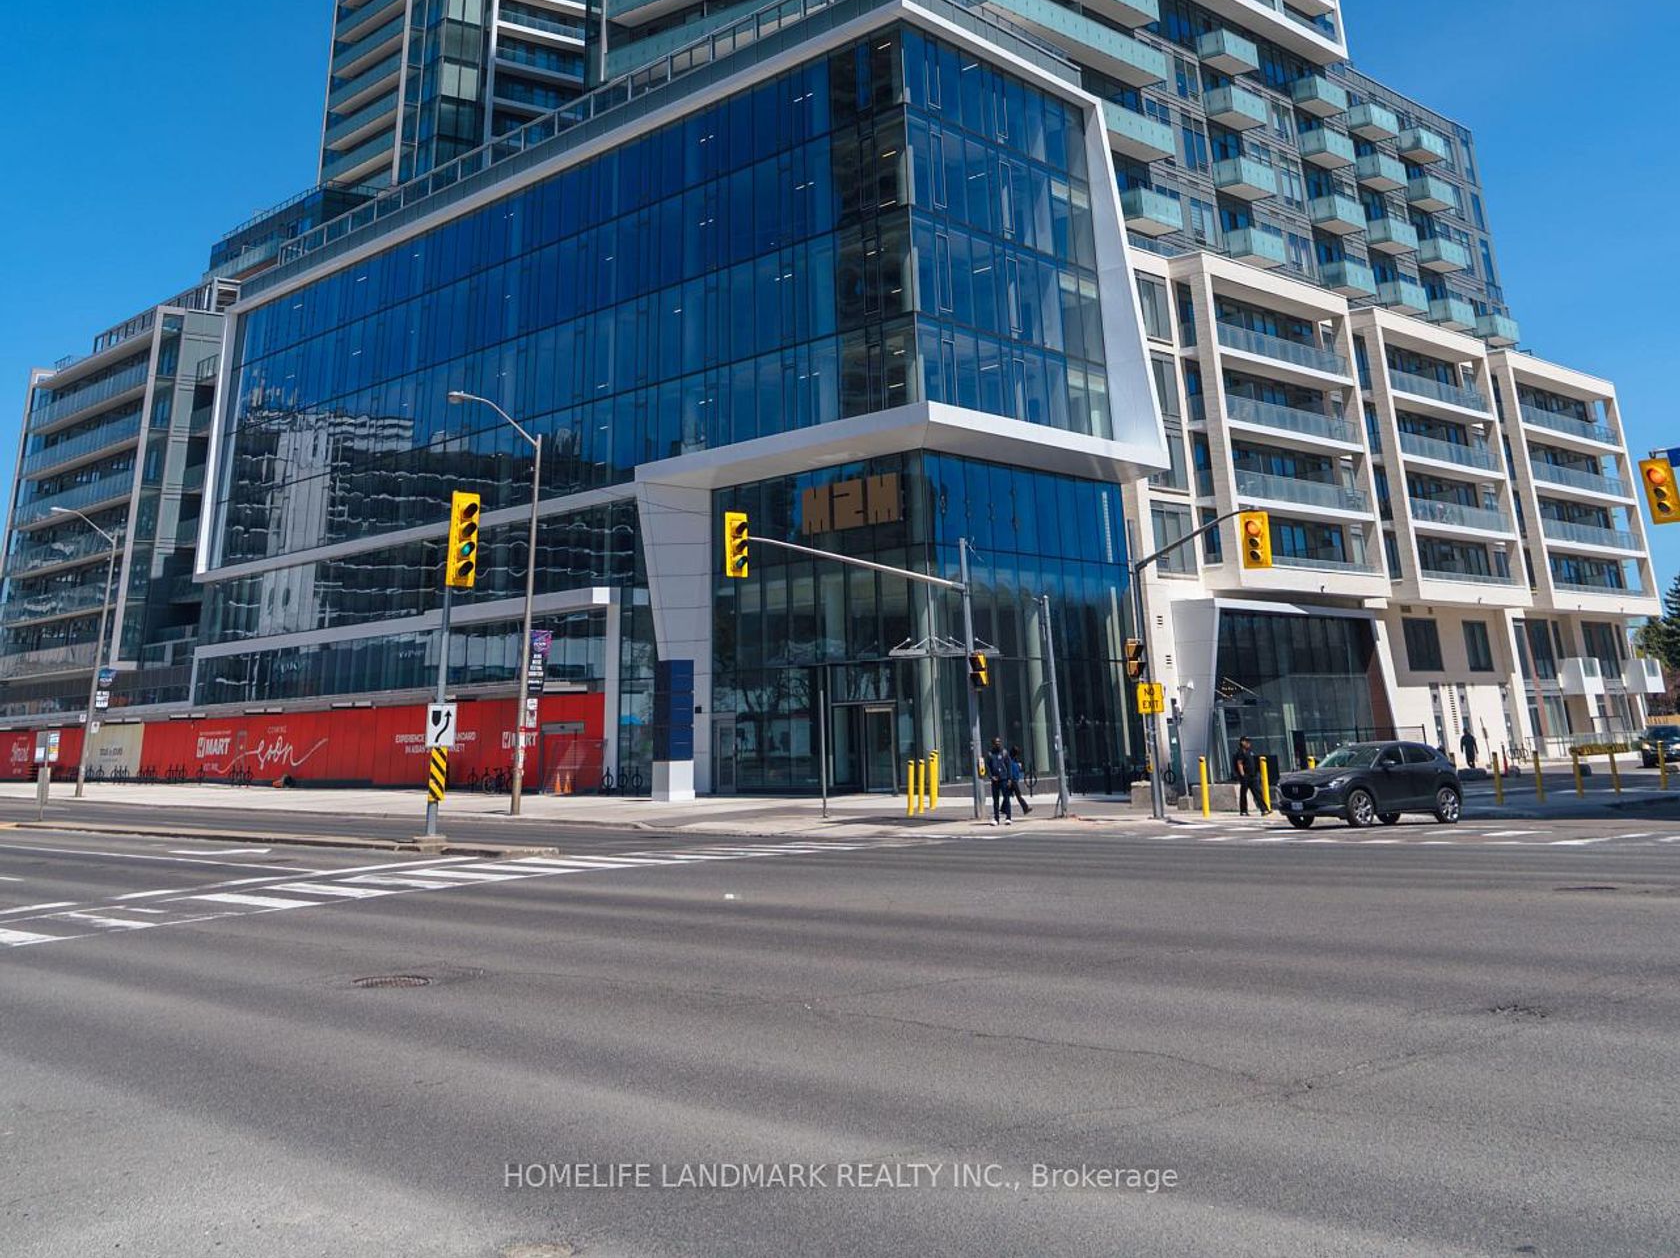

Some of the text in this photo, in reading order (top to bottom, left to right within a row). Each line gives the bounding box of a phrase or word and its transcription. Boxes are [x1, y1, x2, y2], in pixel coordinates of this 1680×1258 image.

[1143, 688, 1154, 696] NO
[1143, 699, 1158, 709] EXIT
[206, 738, 231, 755] MART
